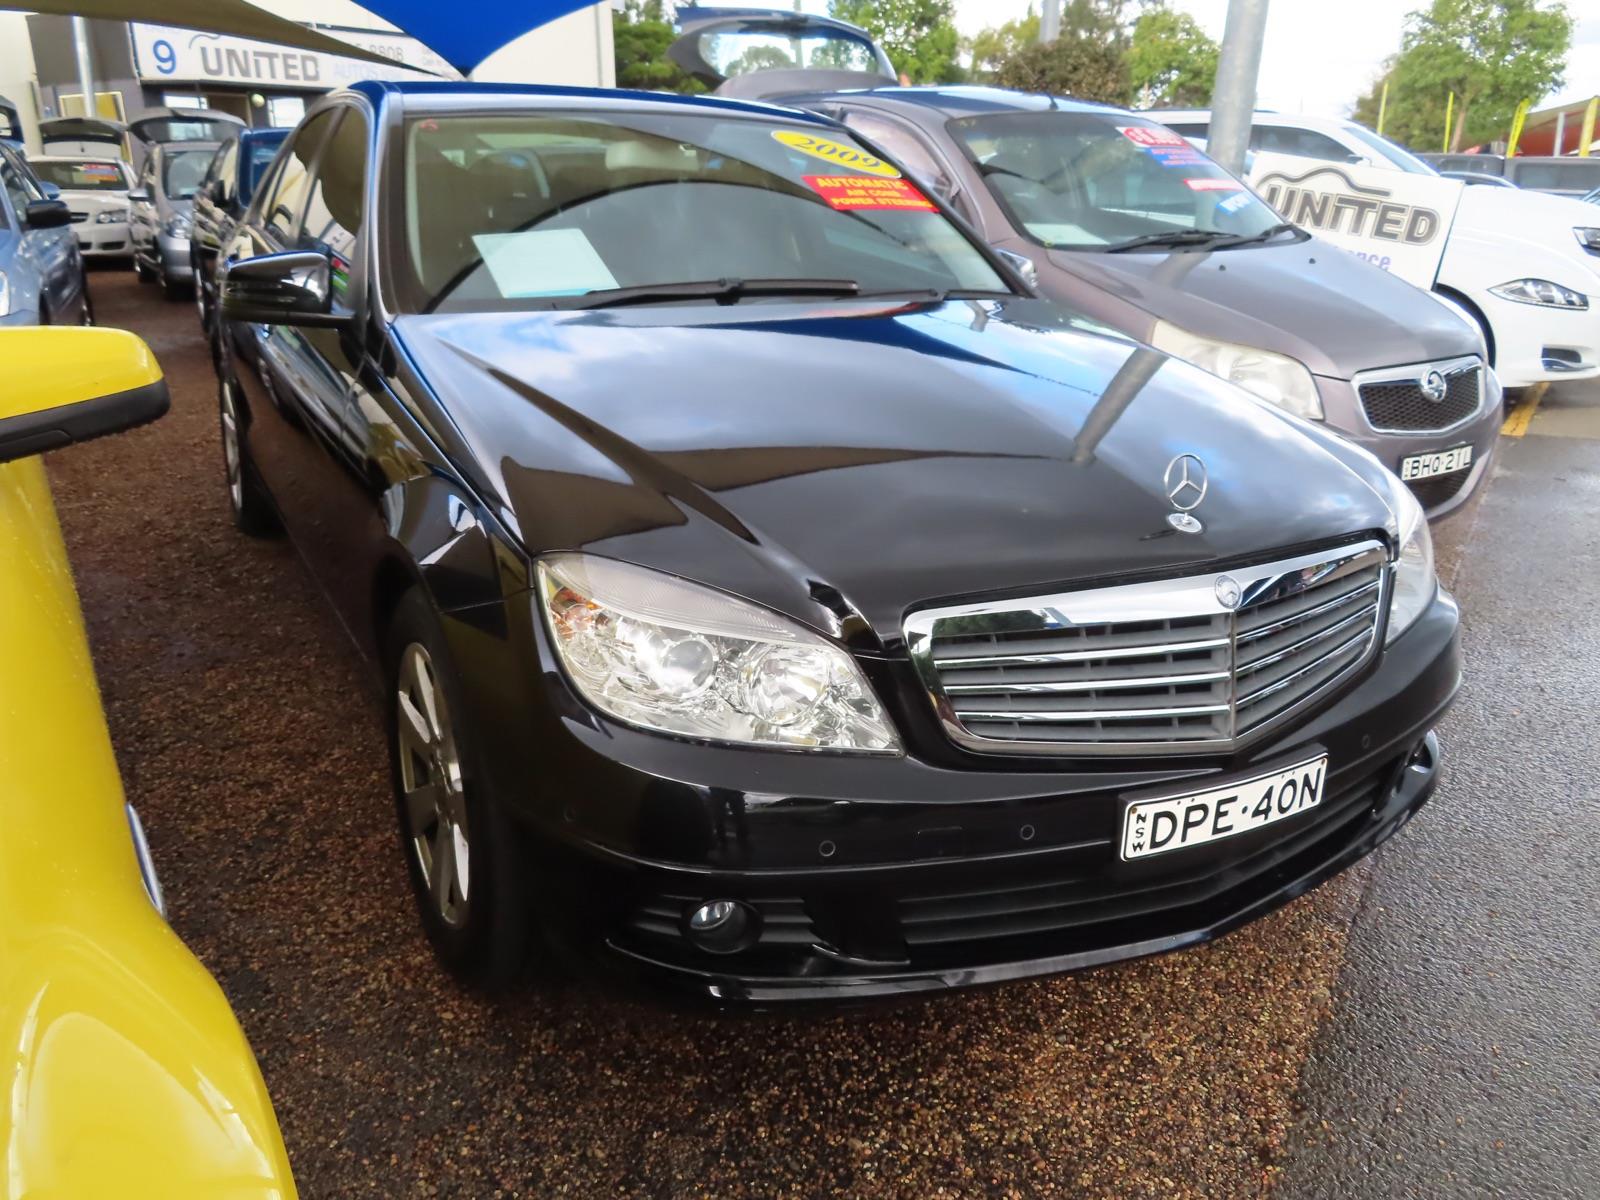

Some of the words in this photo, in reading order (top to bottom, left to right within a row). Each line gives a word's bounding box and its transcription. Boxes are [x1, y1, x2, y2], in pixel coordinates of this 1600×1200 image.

[152, 39, 177, 75] 9
[200, 45, 321, 81] UNITED
[793, 137, 882, 168] 2009
[816, 177, 909, 190] AUTOMATIC
[830, 197, 876, 206] POWER
[1265, 184, 1441, 246] UNITED
[1131, 812, 1148, 853] NSW
